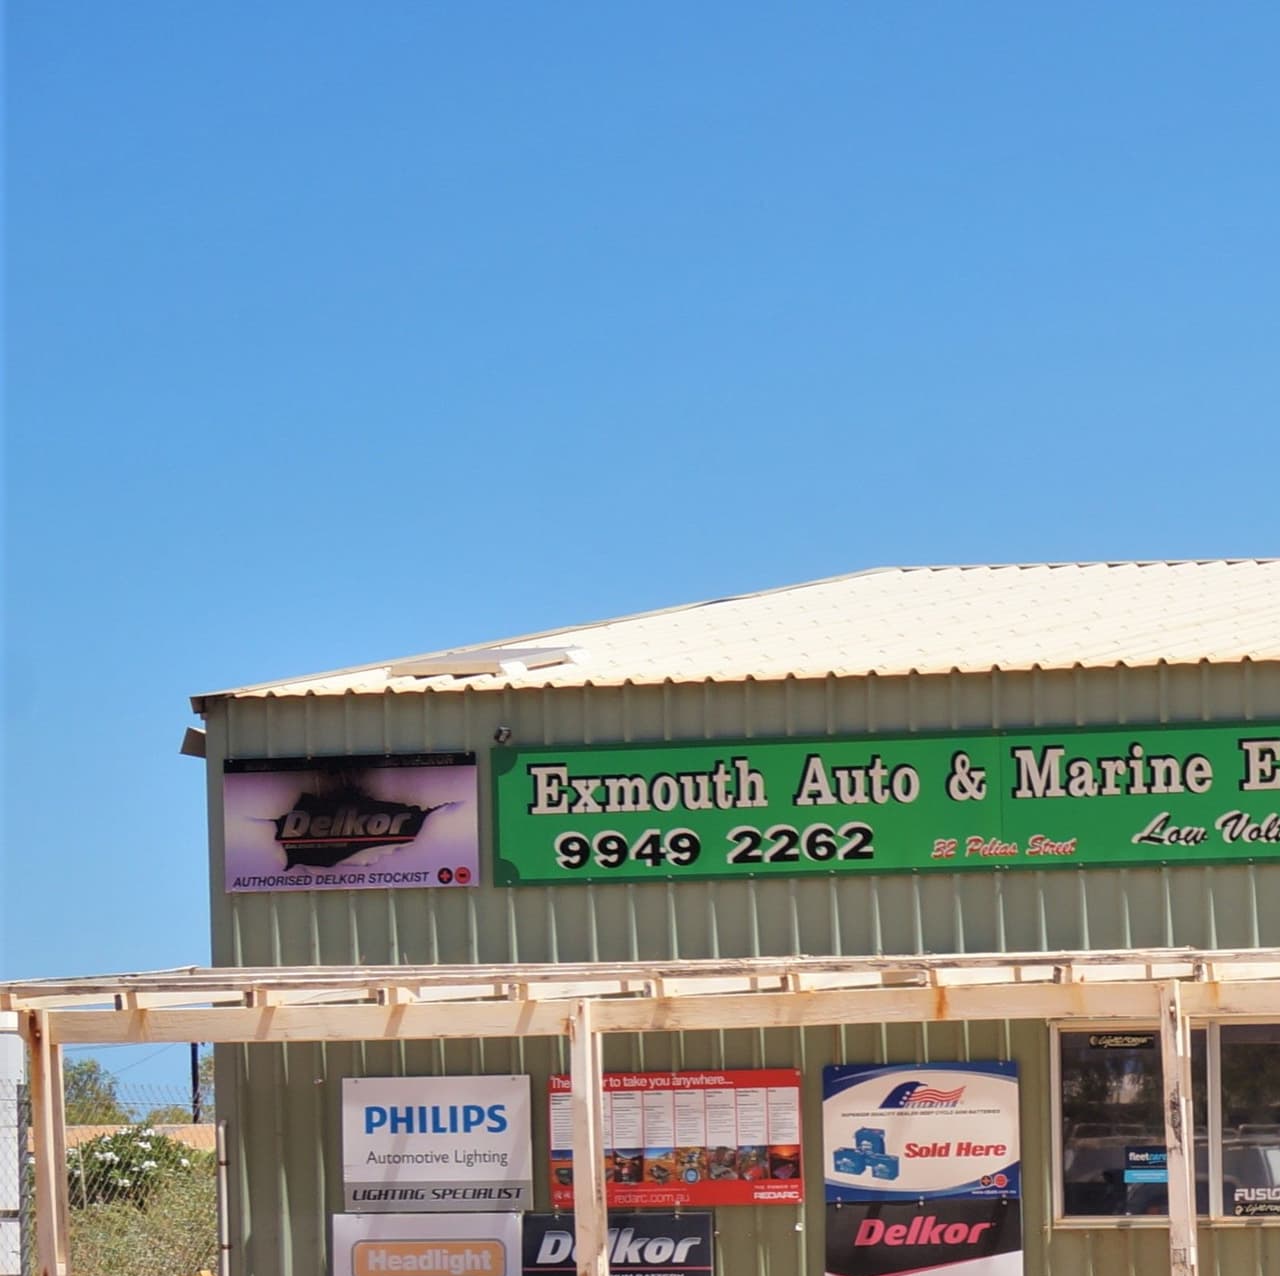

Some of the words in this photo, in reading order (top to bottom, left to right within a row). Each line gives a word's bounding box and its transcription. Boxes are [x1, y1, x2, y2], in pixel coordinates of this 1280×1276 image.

[526, 757, 768, 815] Exmouth
[795, 754, 920, 808] Auto
[946, 750, 987, 801] &
[1011, 743, 1213, 799] Marine
[282, 808, 412, 838] Delkor
[1132, 811, 1208, 847] Low
[555, 823, 701, 870] 9949
[727, 820, 874, 865] 2262
[932, 837, 957, 859] 32
[1025, 833, 1078, 856] Street
[233, 874, 312, 888] AUTHORISED
[316, 873, 364, 886] DELKOR
[367, 871, 429, 884] STOCKIST
[610, 1077, 621, 1088] to
[623, 1076, 647, 1087] take
[648, 1078, 670, 1089] you
[364, 1104, 508, 1135] PHILIPS
[366, 1150, 449, 1165] Automotive
[455, 1150, 508, 1167] Lighting
[904, 1142, 951, 1158] Sold
[956, 1142, 1007, 1157] Here
[352, 1188, 425, 1201] LIGHTING
[432, 1187, 524, 1200] SPECIALIST
[754, 1191, 800, 1200] REDARC
[855, 1215, 990, 1247] Delkor
[536, 1228, 701, 1264] Dlkor
[368, 1249, 492, 1274] Headlight
